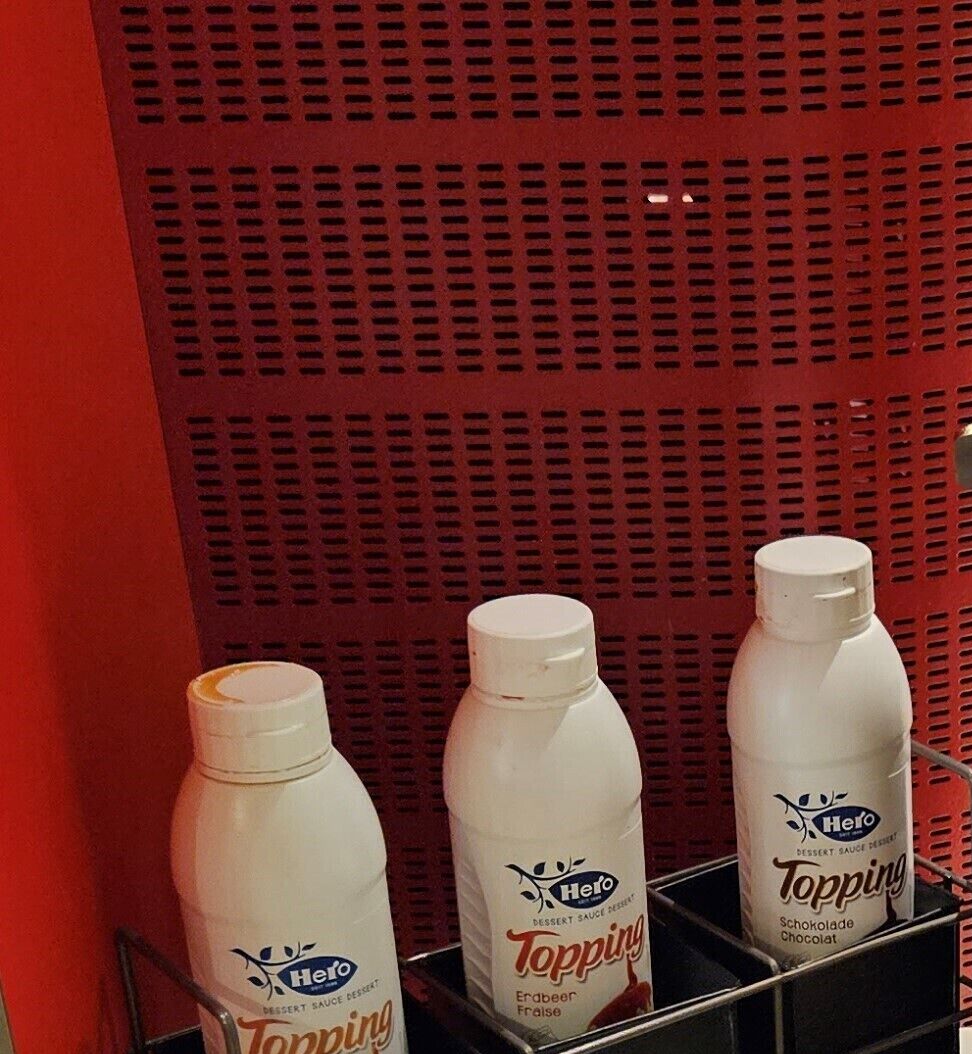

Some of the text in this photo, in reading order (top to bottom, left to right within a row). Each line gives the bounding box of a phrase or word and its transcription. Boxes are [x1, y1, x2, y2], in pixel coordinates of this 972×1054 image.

[822, 811, 875, 833] Hero
[796, 848, 835, 857] DESSERT
[838, 843, 866, 855] SAUCE
[868, 832, 898, 849] DESSERT
[560, 875, 614, 901] Hero
[772, 852, 908, 912] Topping
[533, 916, 573, 927] DESSERT
[577, 909, 606, 923] SAUCE
[608, 893, 635, 914] DESSERT
[779, 916, 854, 931] Schokolade
[505, 913, 645, 983] Topping
[780, 931, 838, 944] Chocolat
[289, 960, 351, 987] Hero
[262, 1003, 307, 1016] DESSERT
[311, 995, 344, 1010] SAUCE
[346, 978, 380, 1001] DESSERT
[516, 990, 577, 1003] Erdbeer
[517, 1005, 562, 1018] Fraise
